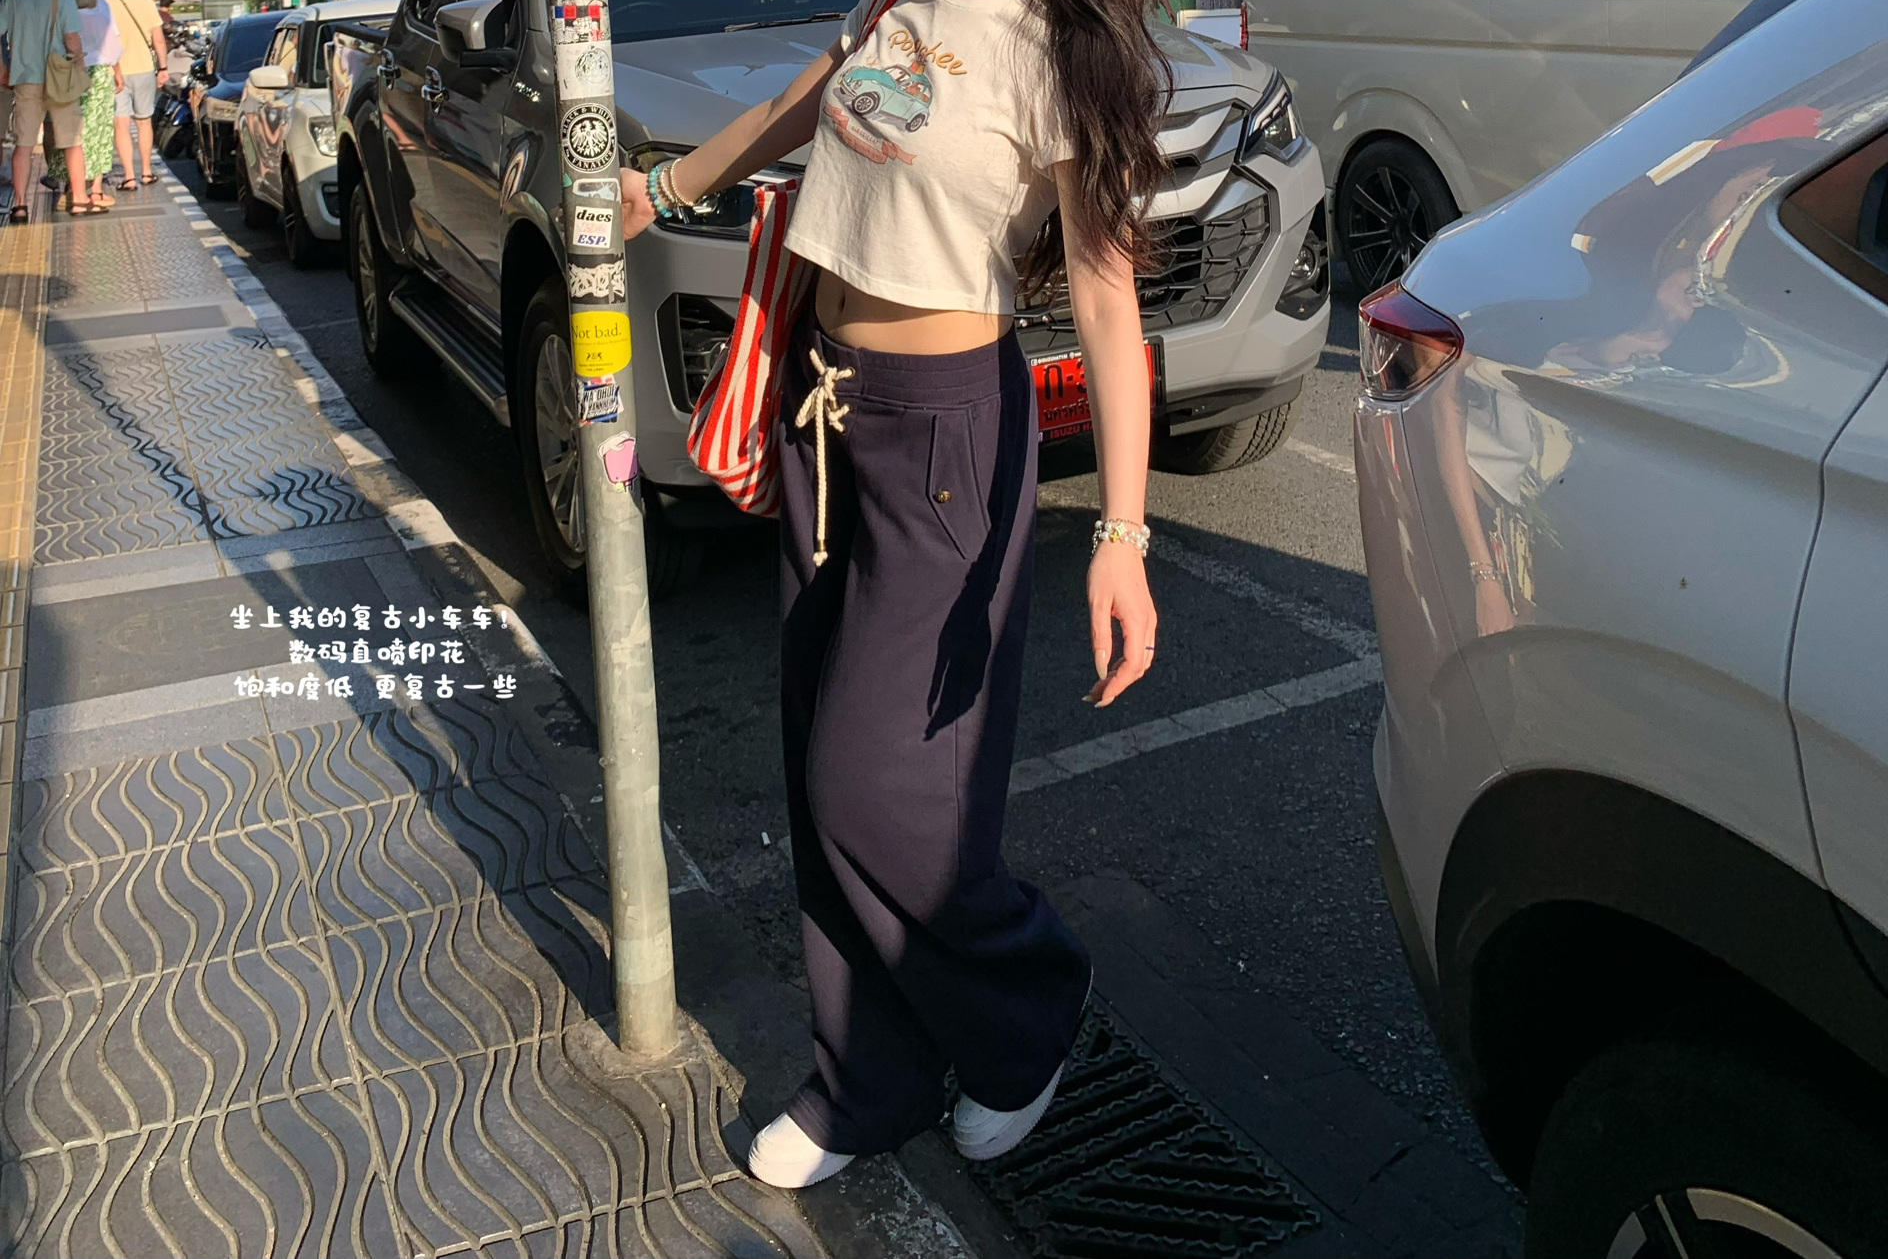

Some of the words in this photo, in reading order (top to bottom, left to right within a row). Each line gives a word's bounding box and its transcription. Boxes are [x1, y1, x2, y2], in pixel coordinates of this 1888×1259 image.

[576, 209, 612, 222] daes
[577, 234, 607, 246] ESP.
[595, 323, 622, 339] bad.
[584, 385, 615, 402] WADHOF
[1050, 425, 1081, 439] ISUZU
